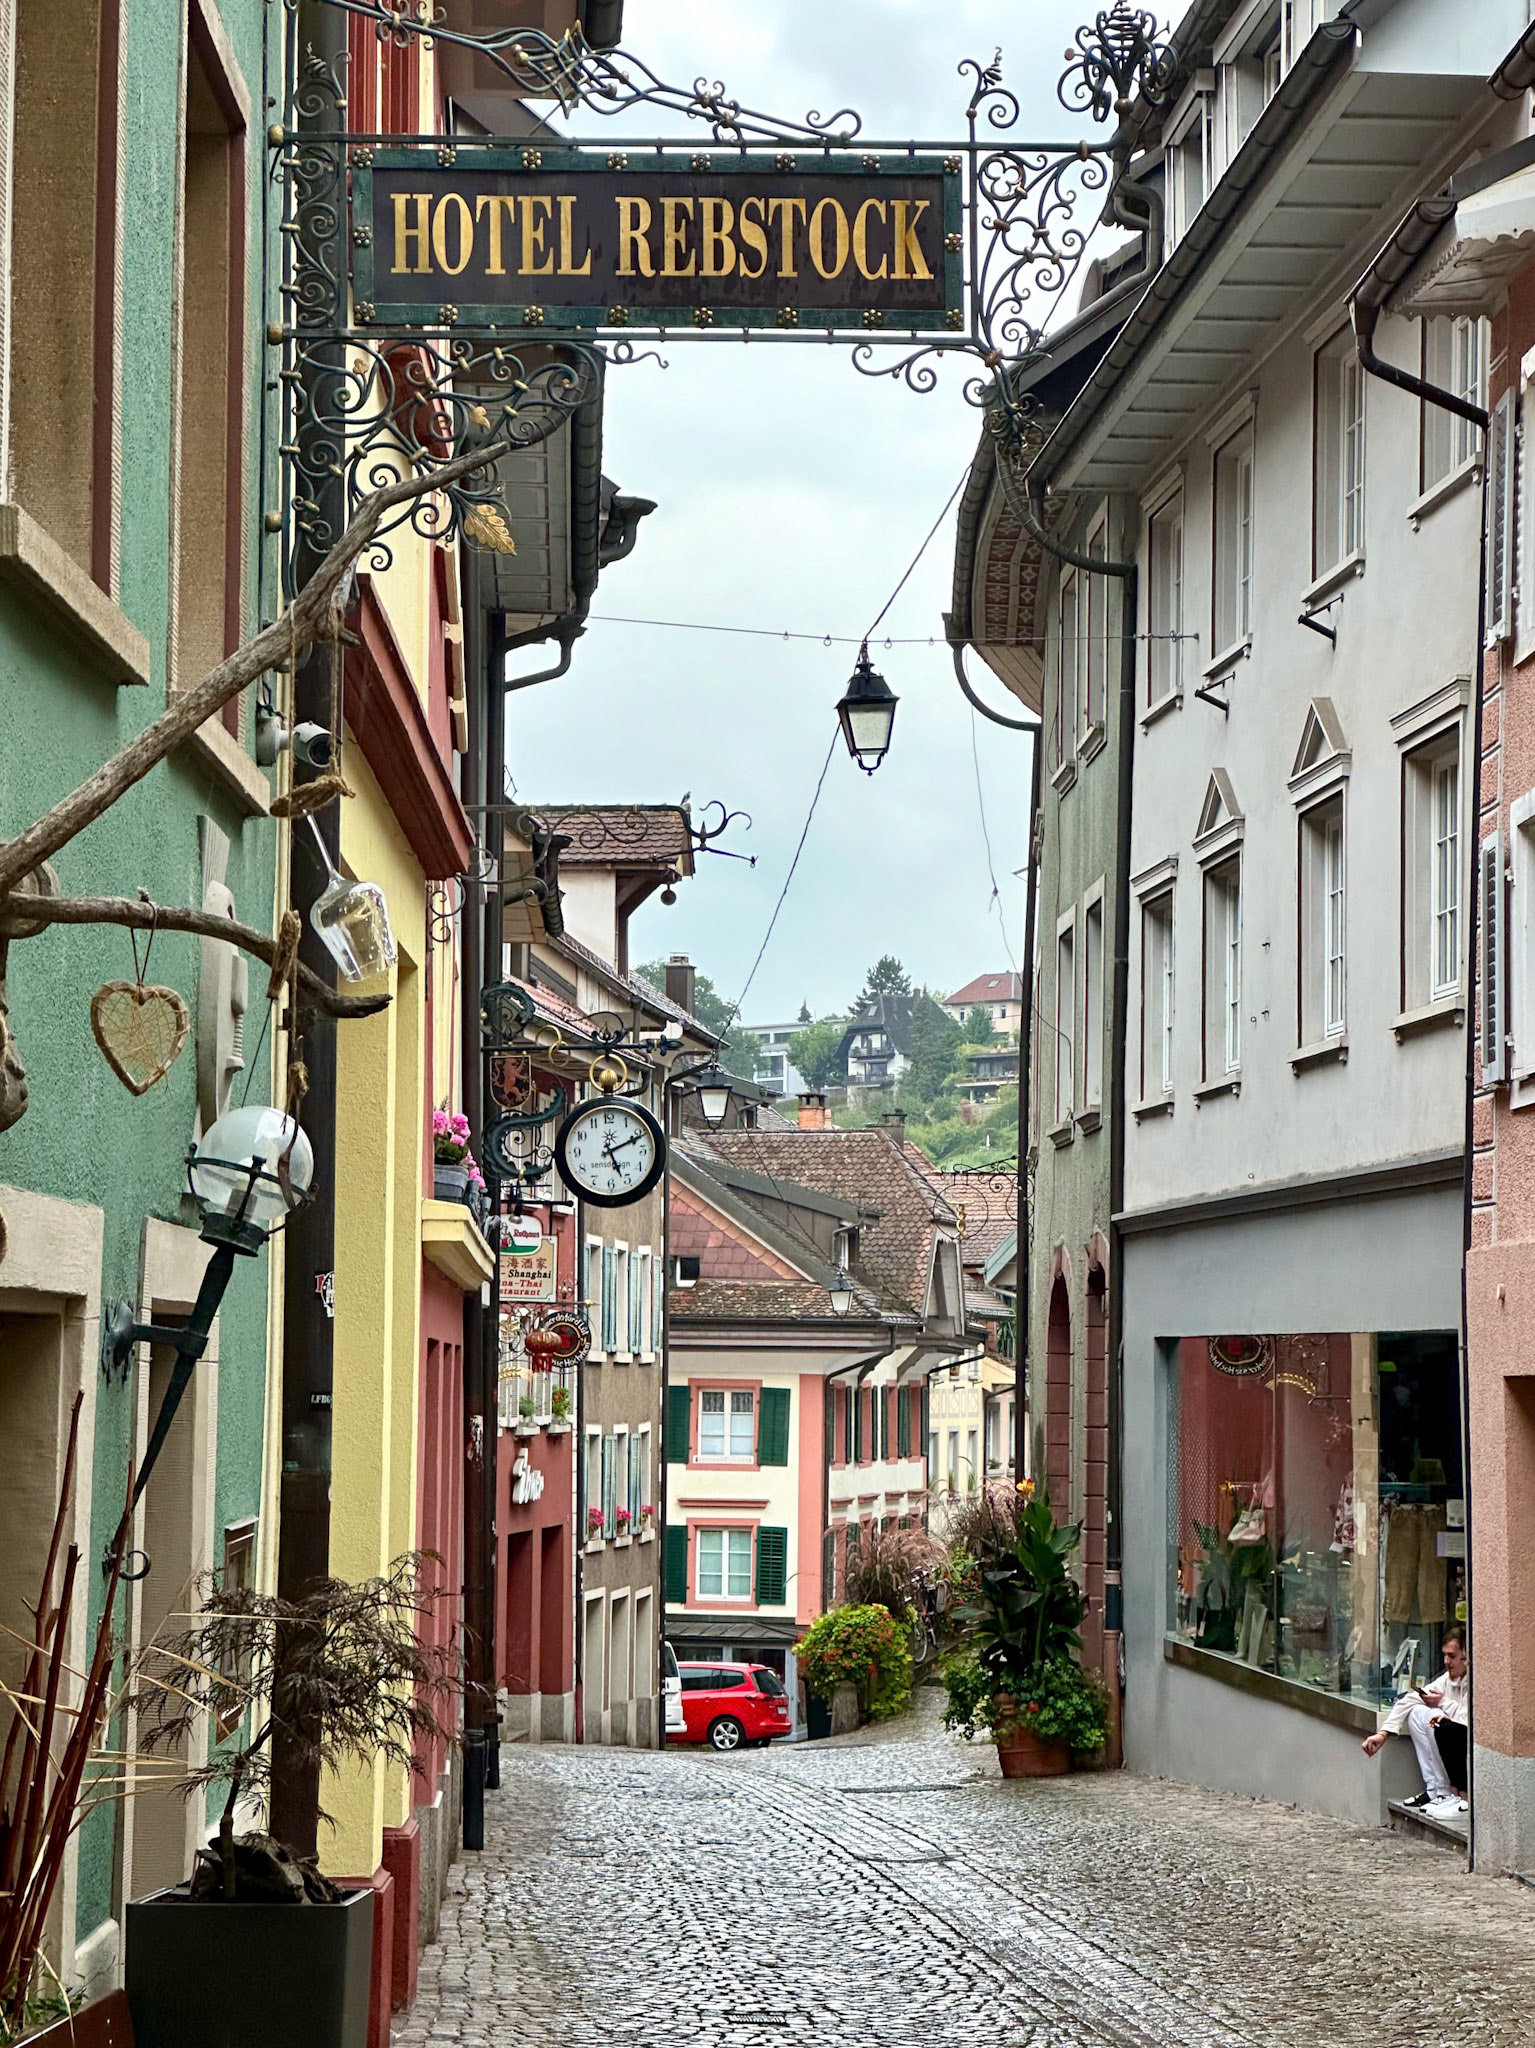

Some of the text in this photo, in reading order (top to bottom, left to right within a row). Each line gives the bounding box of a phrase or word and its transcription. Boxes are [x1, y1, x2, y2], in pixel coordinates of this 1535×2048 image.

[390, 193, 934, 280] HOTEL REBSTOCK
[590, 1118, 597, 1129] 11
[604, 1113, 615, 1124] 12
[624, 1117, 628, 1128] 1
[577, 1131, 587, 1141] 10
[573, 1147, 581, 1158] 9
[579, 1164, 586, 1174] 8
[590, 1160, 631, 1169] sensdign
[635, 1161, 642, 1172] 4
[590, 1175, 599, 1186] 7
[607, 1178, 615, 1190] 6
[624, 1173, 631, 1185] 5
[513, 1228, 540, 1239] Rothaus
[508, 1269, 552, 1280] Shanghai
[501, 1280, 542, 1288] na-Thai
[499, 1287, 541, 1296] staurant
